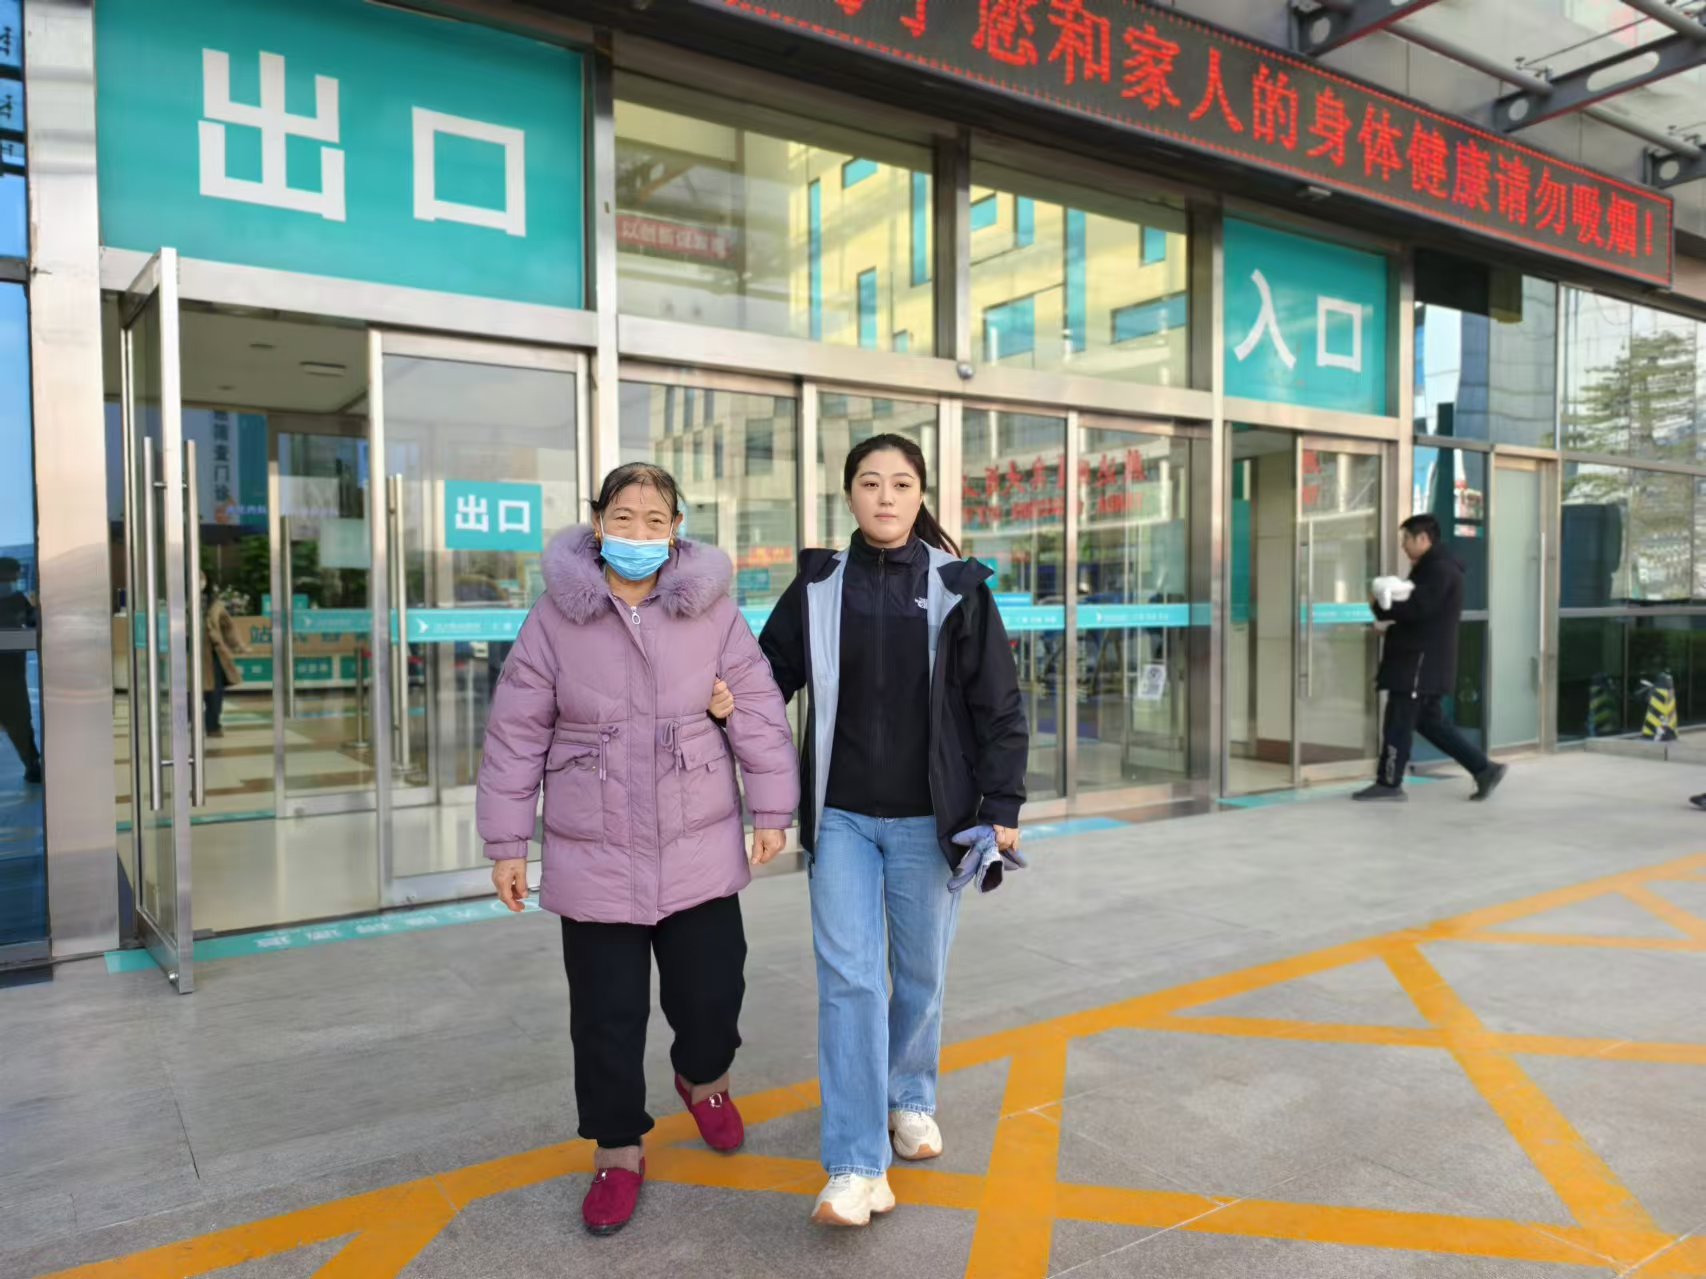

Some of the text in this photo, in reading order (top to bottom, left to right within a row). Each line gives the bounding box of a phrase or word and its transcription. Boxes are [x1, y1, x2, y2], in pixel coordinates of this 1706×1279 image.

[199, 48, 526, 237] 出口
[835, 0, 1654, 258] 您和家人的身体健康请勿吸烟!
[1234, 269, 1362, 372] 入口
[455, 494, 531, 534] 出口
